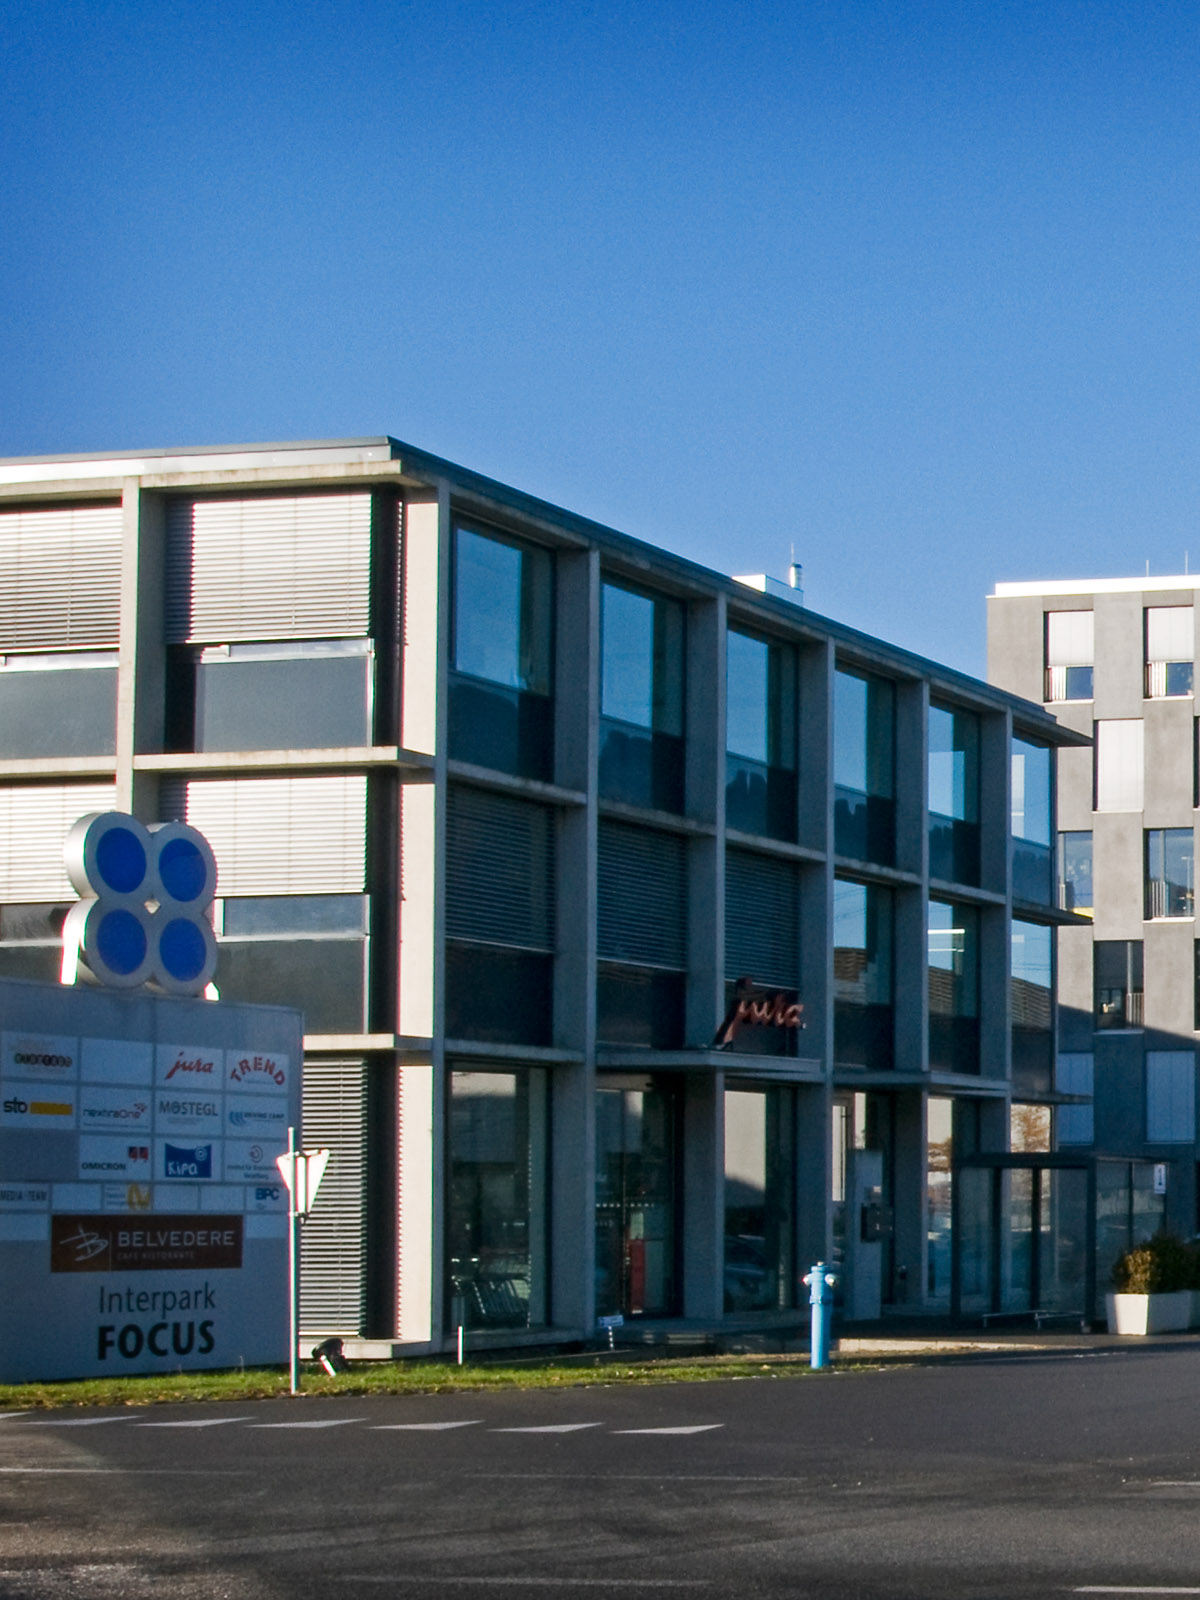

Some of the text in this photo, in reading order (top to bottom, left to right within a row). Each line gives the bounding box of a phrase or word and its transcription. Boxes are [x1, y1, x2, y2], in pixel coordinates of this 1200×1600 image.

[165, 1051, 214, 1080] jura
[230, 1056, 286, 1086] TREND
[3, 1096, 28, 1114] sto
[81, 1162, 127, 1171] OMICRON
[255, 1187, 280, 1201] BPC
[117, 1230, 235, 1247] BELVEDERE
[99, 1281, 215, 1320] Interpark
[97, 1320, 215, 1361] FOCUS
